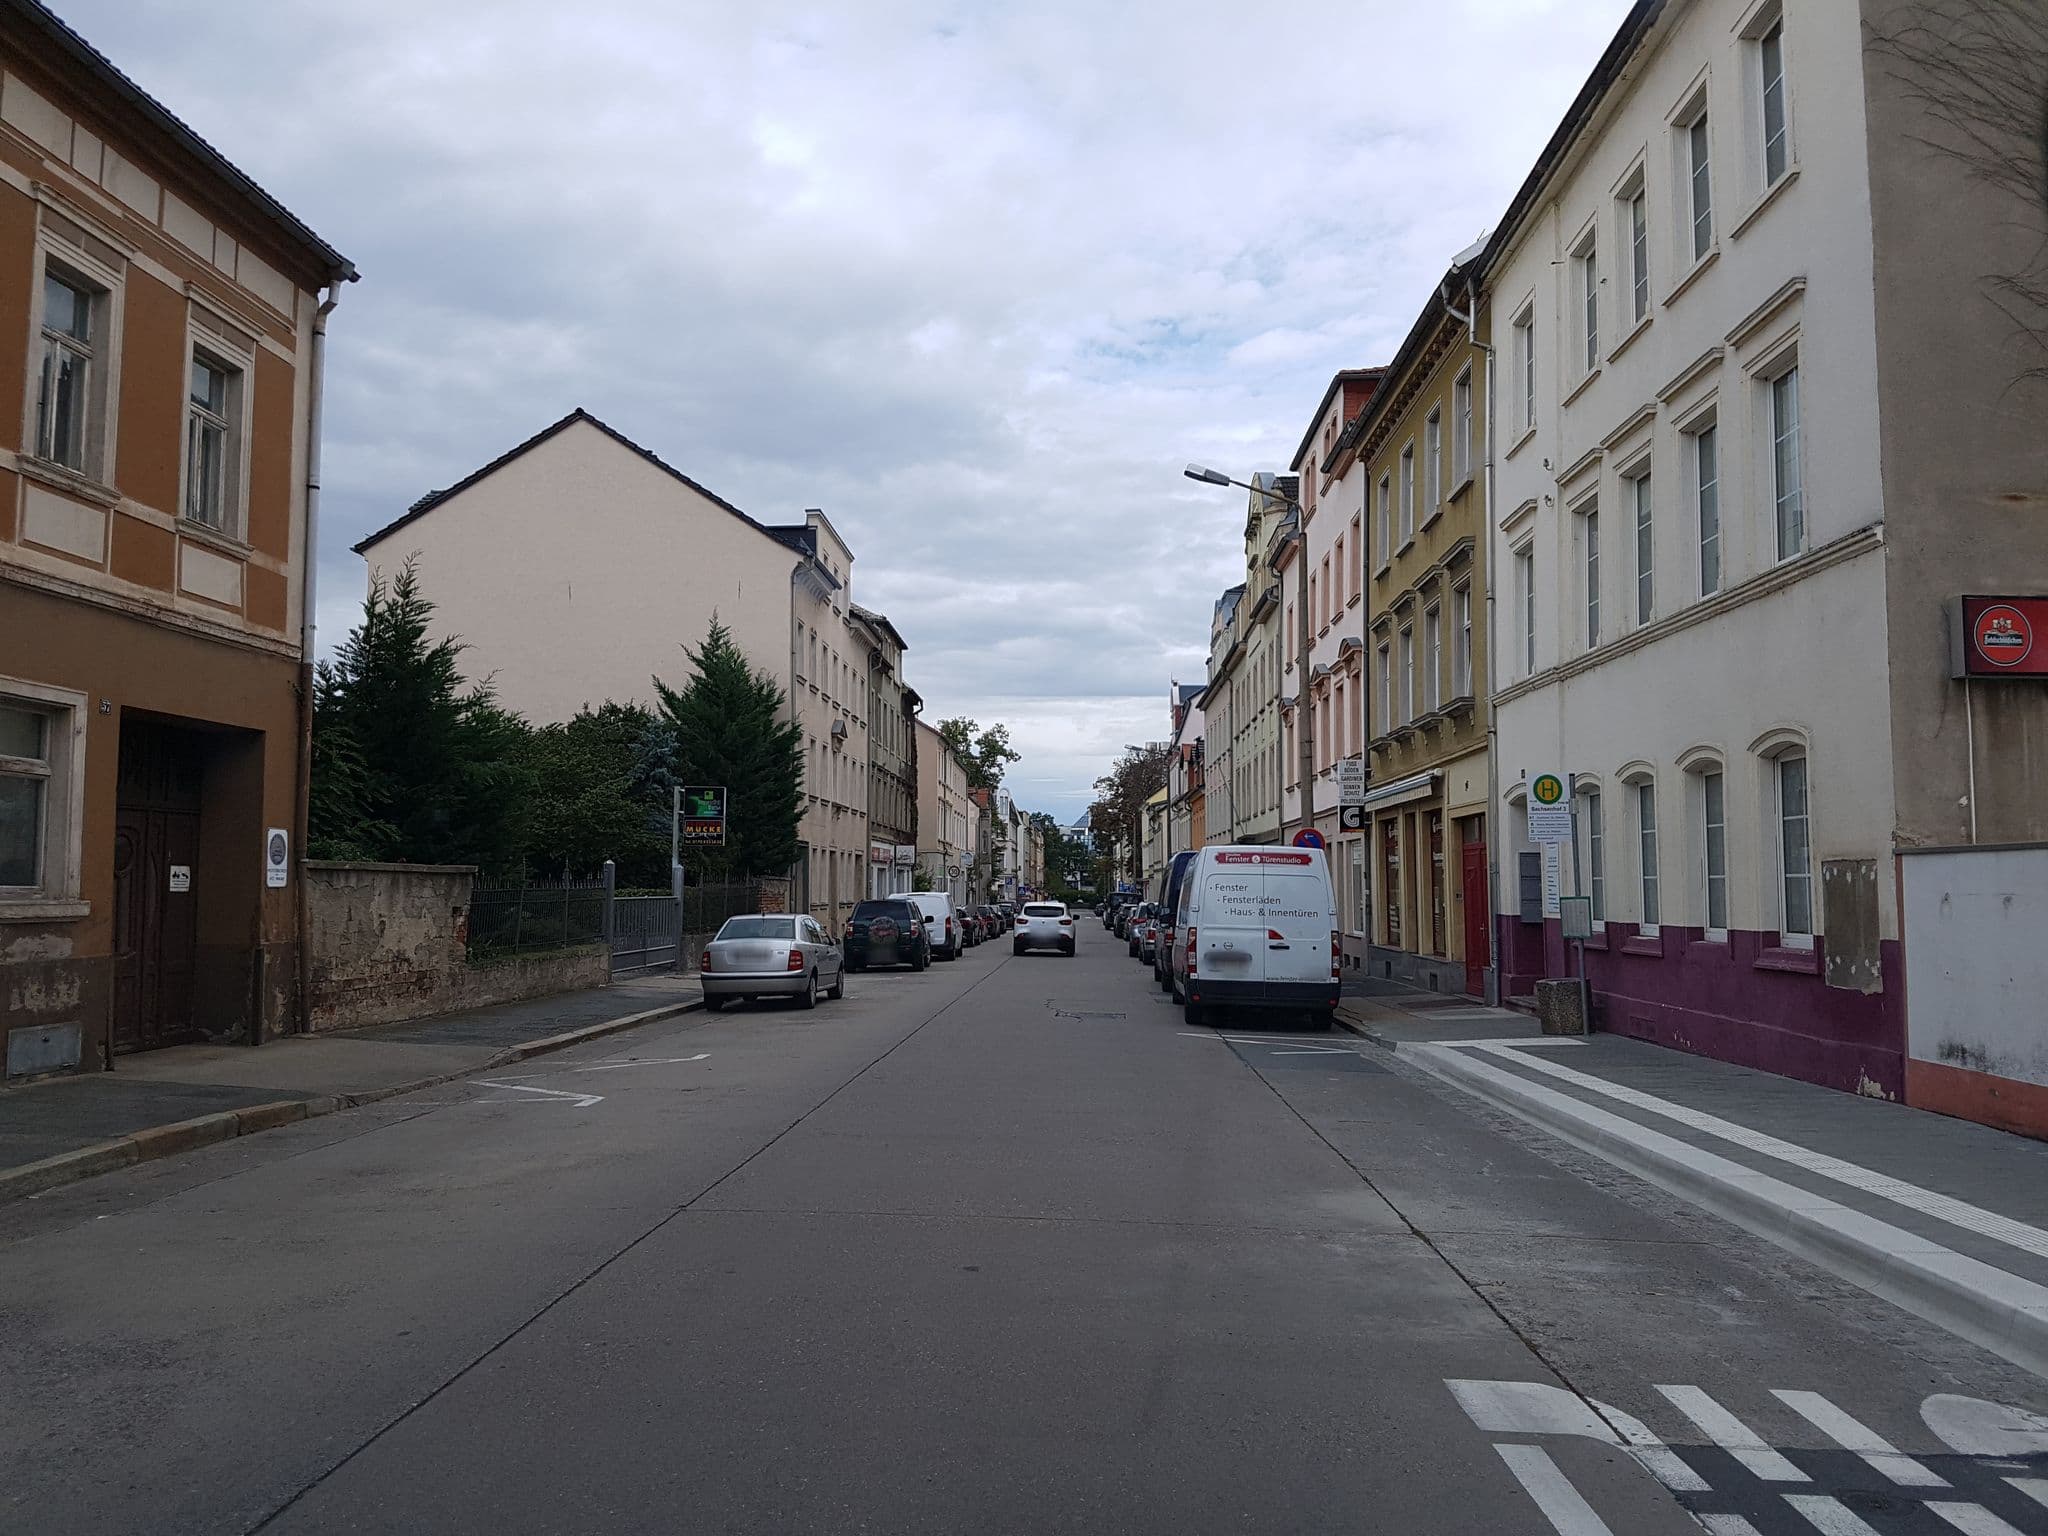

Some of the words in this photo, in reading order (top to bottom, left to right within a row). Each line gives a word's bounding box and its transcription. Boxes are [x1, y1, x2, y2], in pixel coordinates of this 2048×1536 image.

[1541, 781, 1554, 797] H
[1225, 856, 1250, 864] Fenster
[1262, 856, 1302, 864] Türenstudio
[1215, 884, 1249, 892] Fenster
[1222, 895, 1281, 905] Fensterläden
[1230, 908, 1255, 916] Haus-
[1258, 908, 1266, 916] &
[1268, 908, 1319, 918] Innentüren
